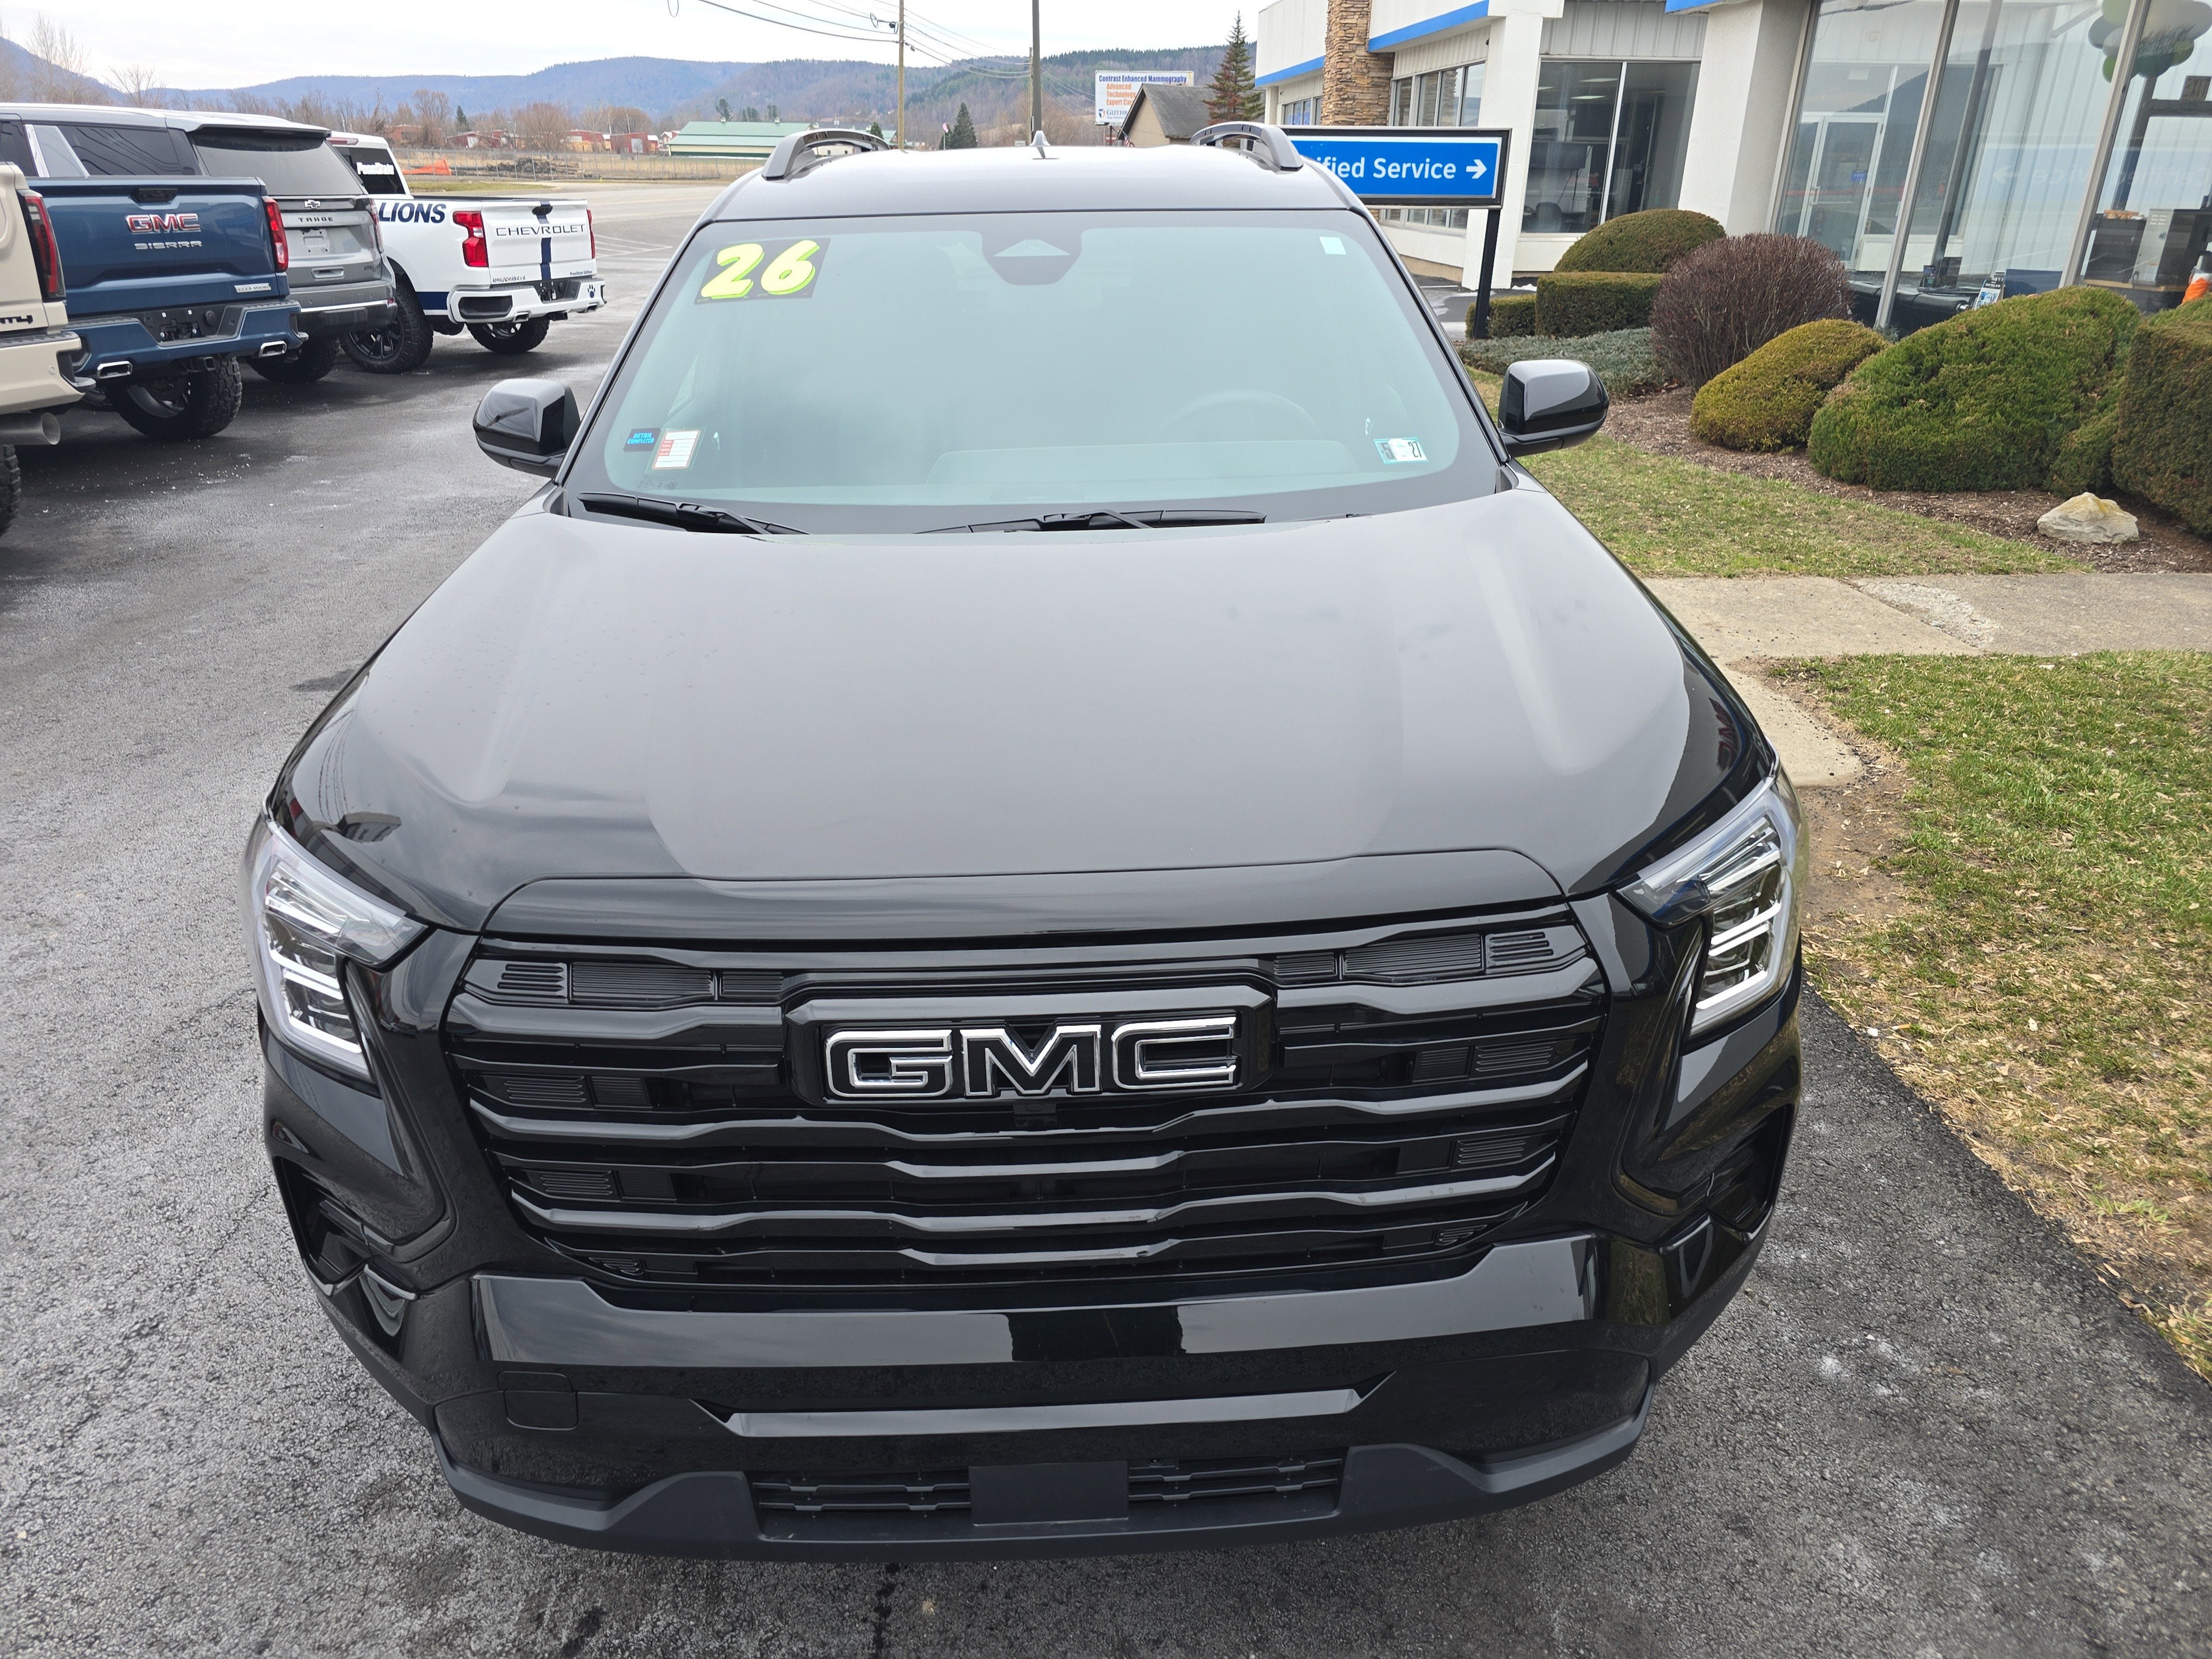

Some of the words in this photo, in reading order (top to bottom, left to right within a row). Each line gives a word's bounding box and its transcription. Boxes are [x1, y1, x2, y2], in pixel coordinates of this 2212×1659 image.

[1148, 75, 1187, 83] Mammography
[1372, 157, 1457, 179] Service
[378, 202, 447, 223] LIONS
[126, 213, 202, 234] GMC
[496, 224, 585, 236] CHEVROLET
[134, 241, 202, 250] SIERRA
[700, 240, 820, 300] 26
[1408, 441, 1422, 458] 27
[826, 1016, 1238, 1098] GMC
